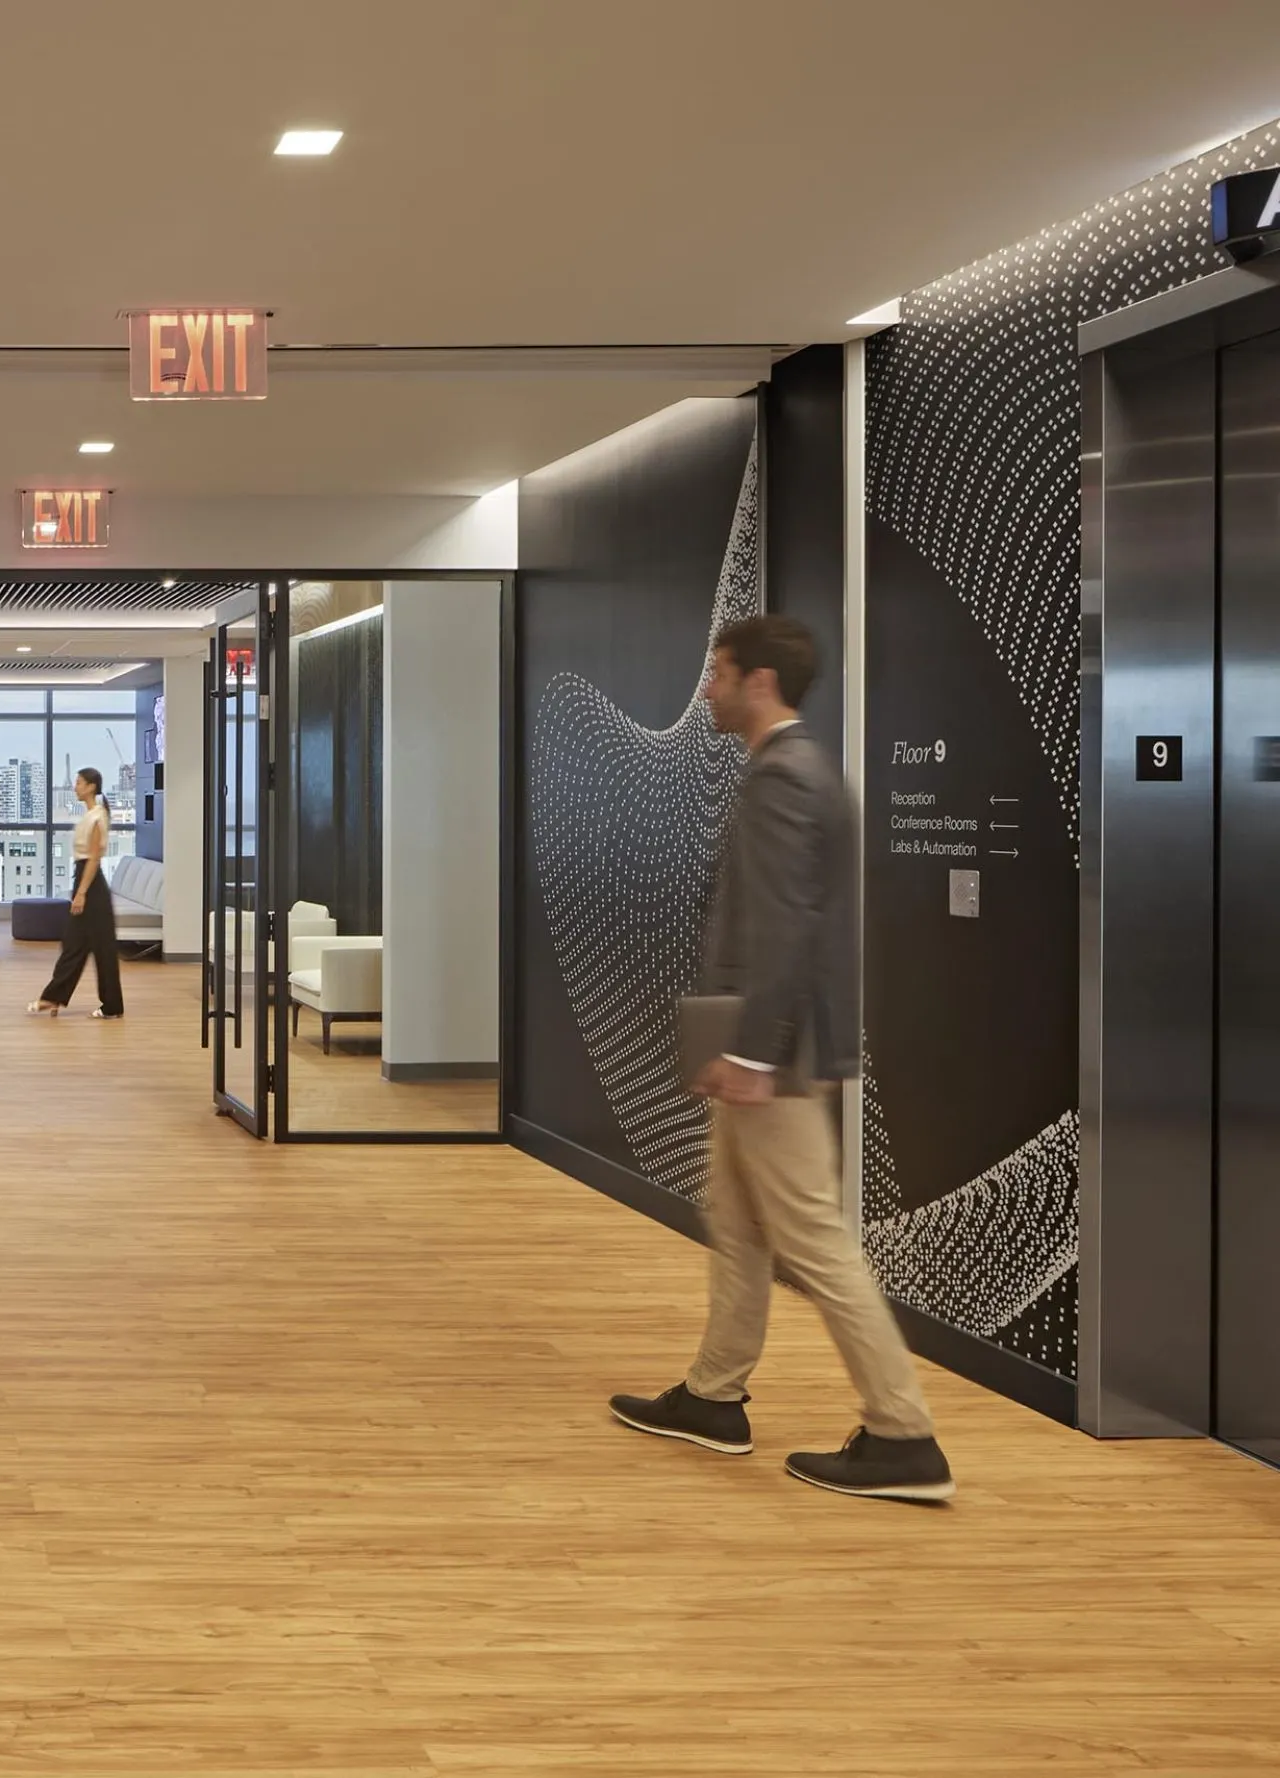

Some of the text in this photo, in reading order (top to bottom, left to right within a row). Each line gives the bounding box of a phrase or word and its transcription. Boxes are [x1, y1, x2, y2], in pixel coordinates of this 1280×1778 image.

[149, 313, 254, 392] EXIT
[33, 491, 101, 543] EXIT
[891, 739, 946, 764] Floor 9
[1152, 741, 1168, 768] 9
[891, 791, 935, 807] Reception
[891, 815, 978, 831] Conference Rooms
[891, 840, 977, 856] Labs & Automation
